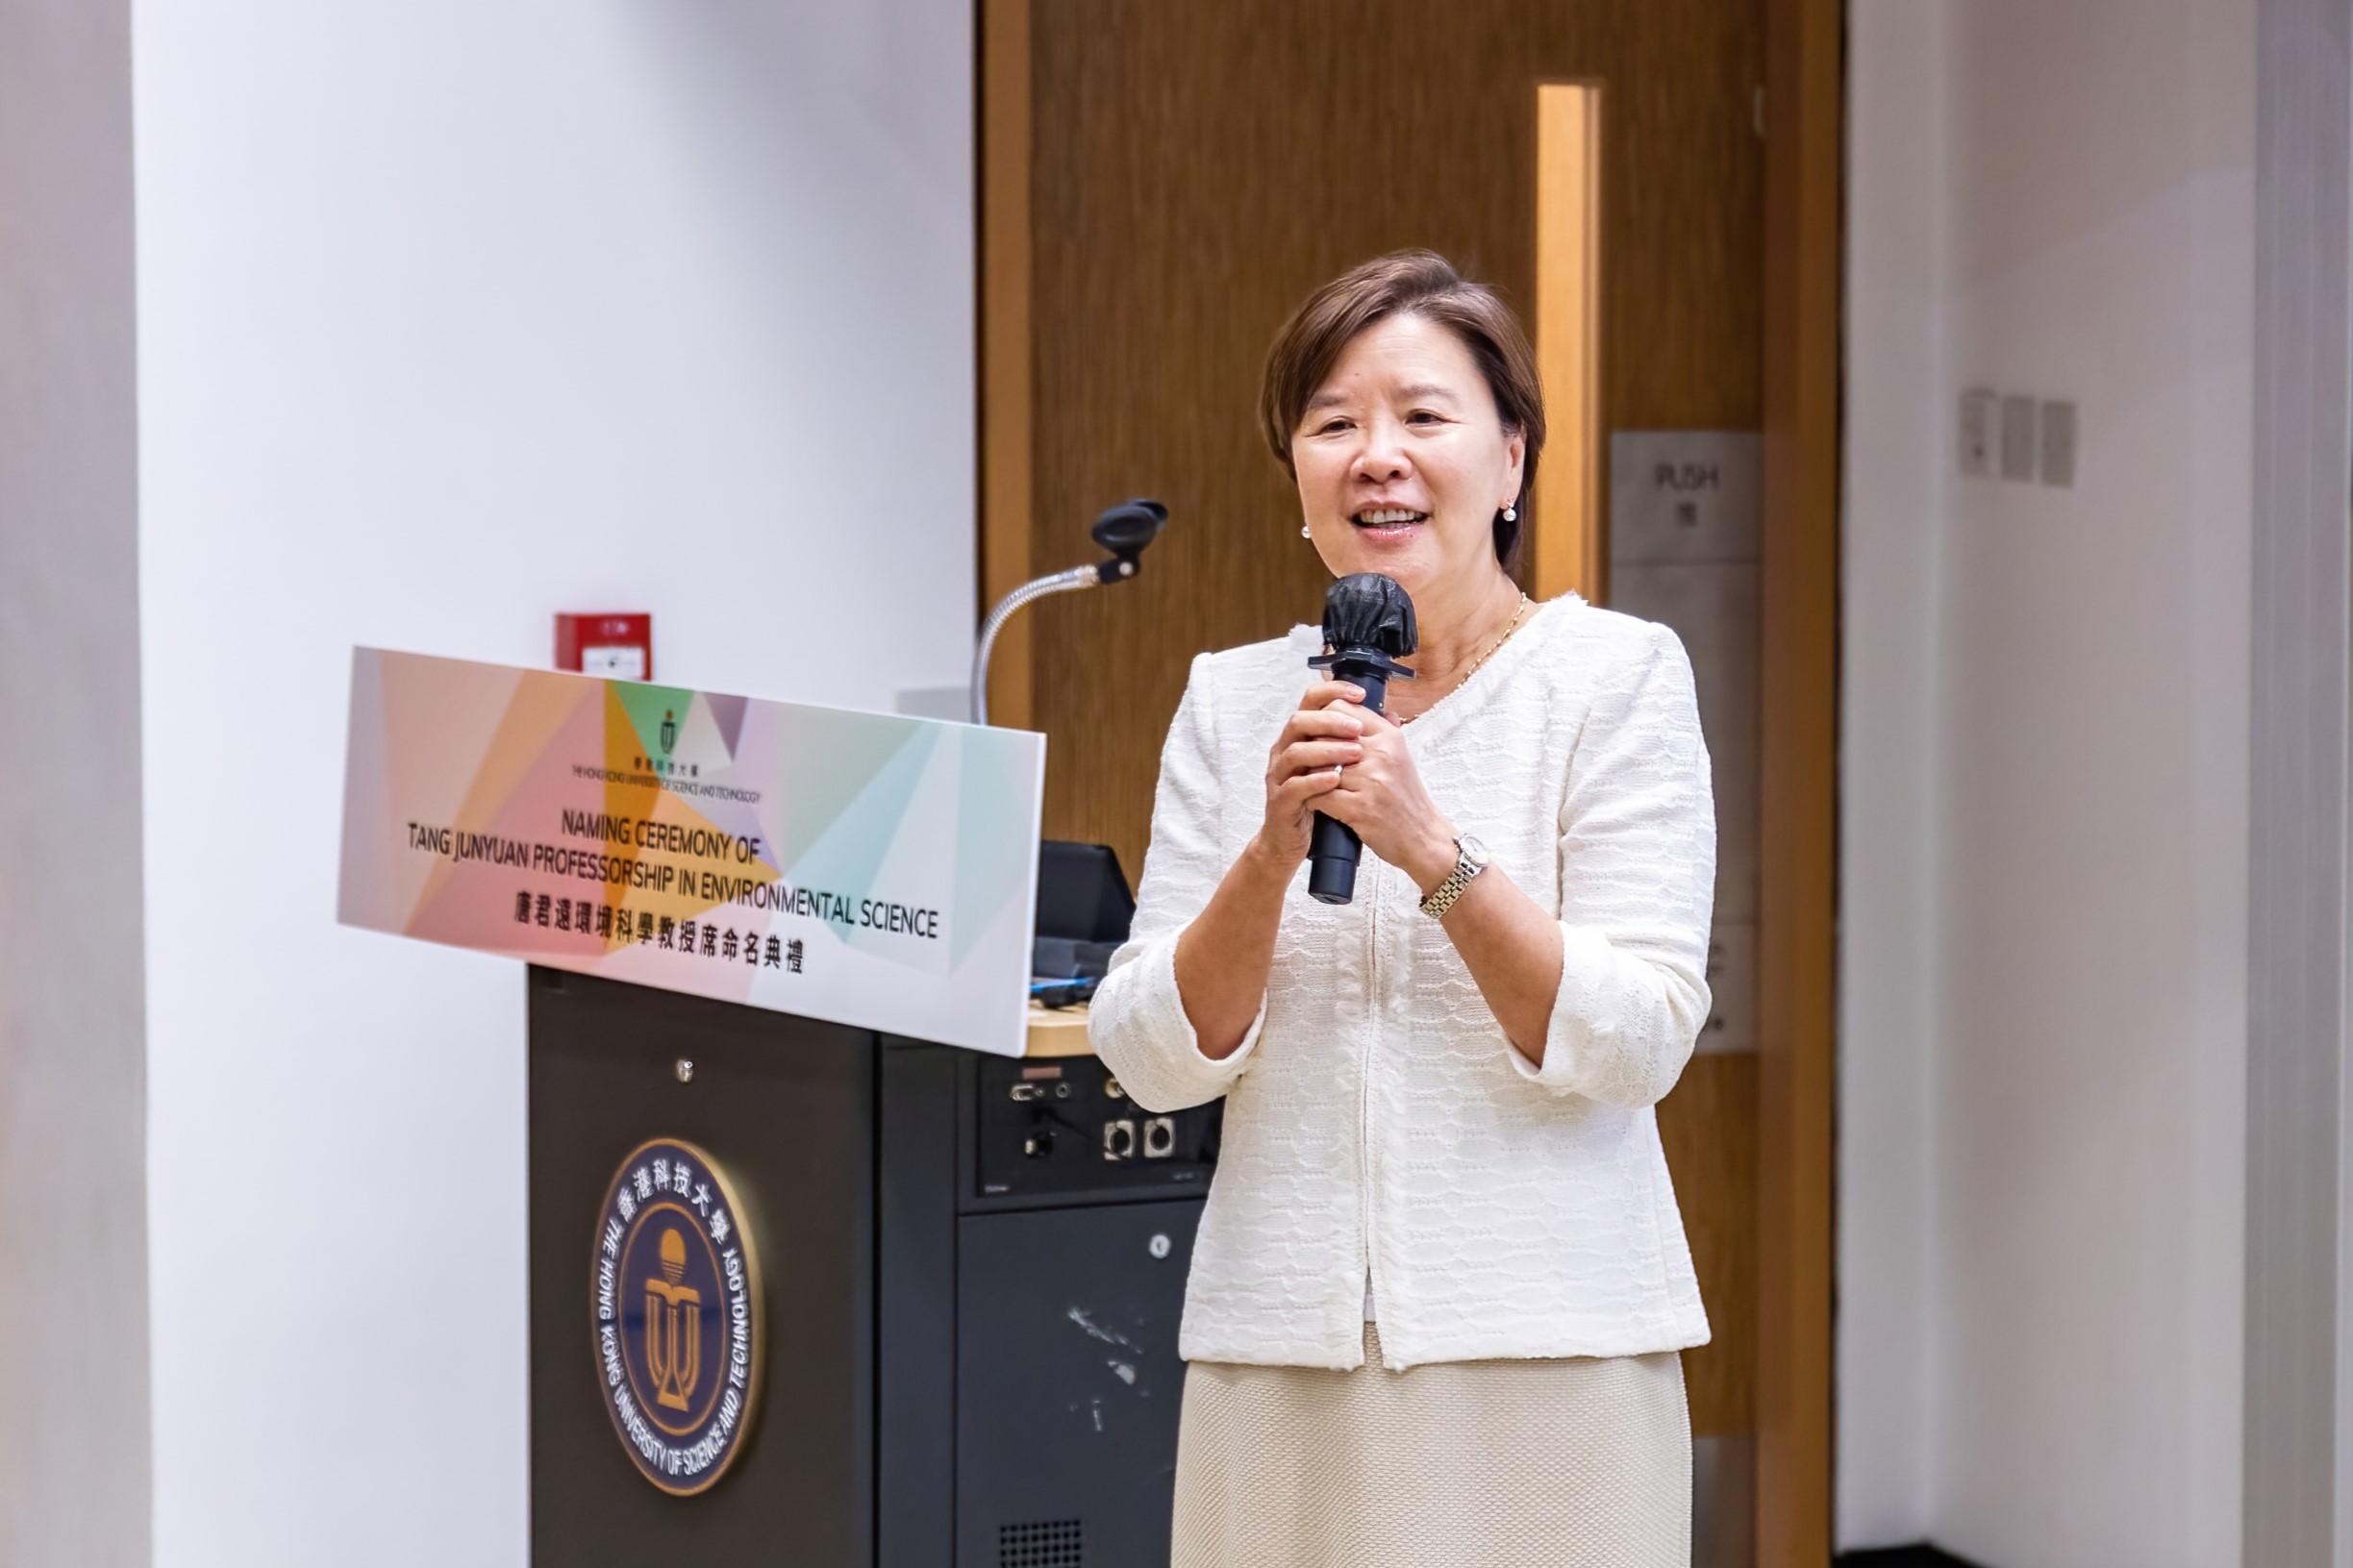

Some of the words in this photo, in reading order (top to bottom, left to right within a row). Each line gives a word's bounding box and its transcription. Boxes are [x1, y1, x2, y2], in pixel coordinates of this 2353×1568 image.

[1654, 463, 1719, 491] PUSH
[700, 784, 715, 798] AND
[716, 786, 761, 804] TECHNOLOGY
[562, 809, 631, 845] NAMING
[635, 819, 732, 861] CEREMONY
[736, 835, 762, 864] OF
[408, 822, 450, 855] TANG
[453, 832, 529, 868] JUNYUAN
[533, 844, 674, 893] PROFESSORSHIP
[678, 869, 696, 896] IN
[701, 872, 855, 925] ENVIRONMENTAL
[860, 899, 939, 939] SCIENCE
[602, 1216, 624, 1258] THE
[598, 1258, 616, 1320] HONG
[722, 1247, 750, 1389] TECHNOLOGY
[600, 1324, 624, 1387] KONG
[613, 1385, 667, 1471] UNIVERSITY
[718, 1386, 742, 1435] AND
[667, 1448, 684, 1477] OF
[683, 1422, 728, 1476] SCIENCE
